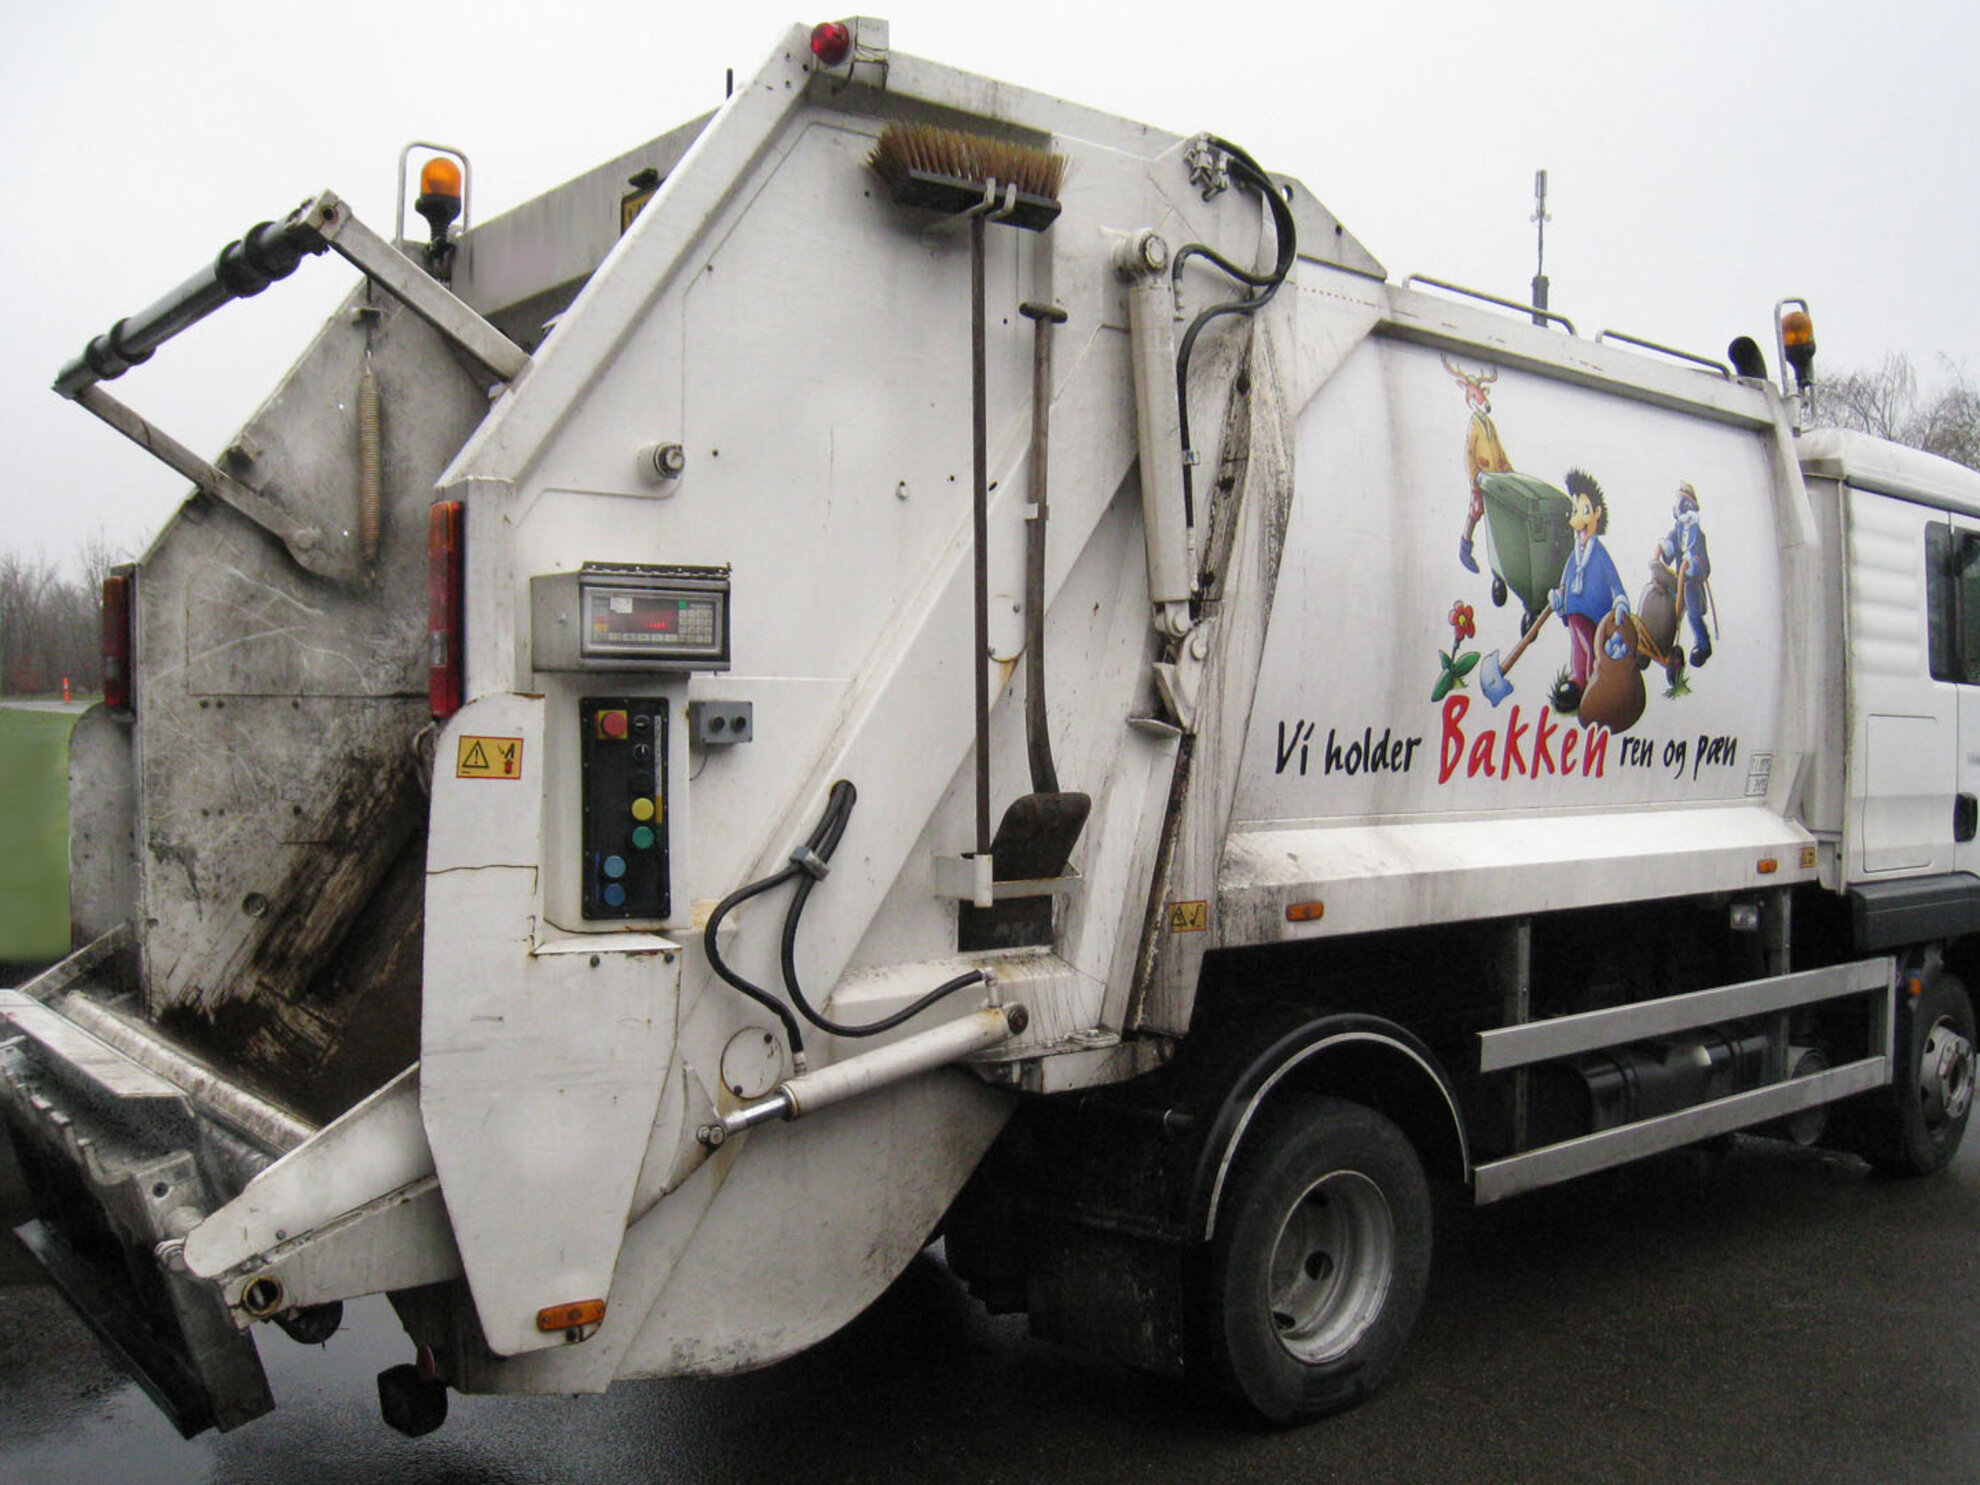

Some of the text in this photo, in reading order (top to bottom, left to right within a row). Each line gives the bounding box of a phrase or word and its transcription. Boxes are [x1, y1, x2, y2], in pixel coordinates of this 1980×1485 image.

[1275, 695, 1737, 785] Vi holder Bakken ren og pæn
